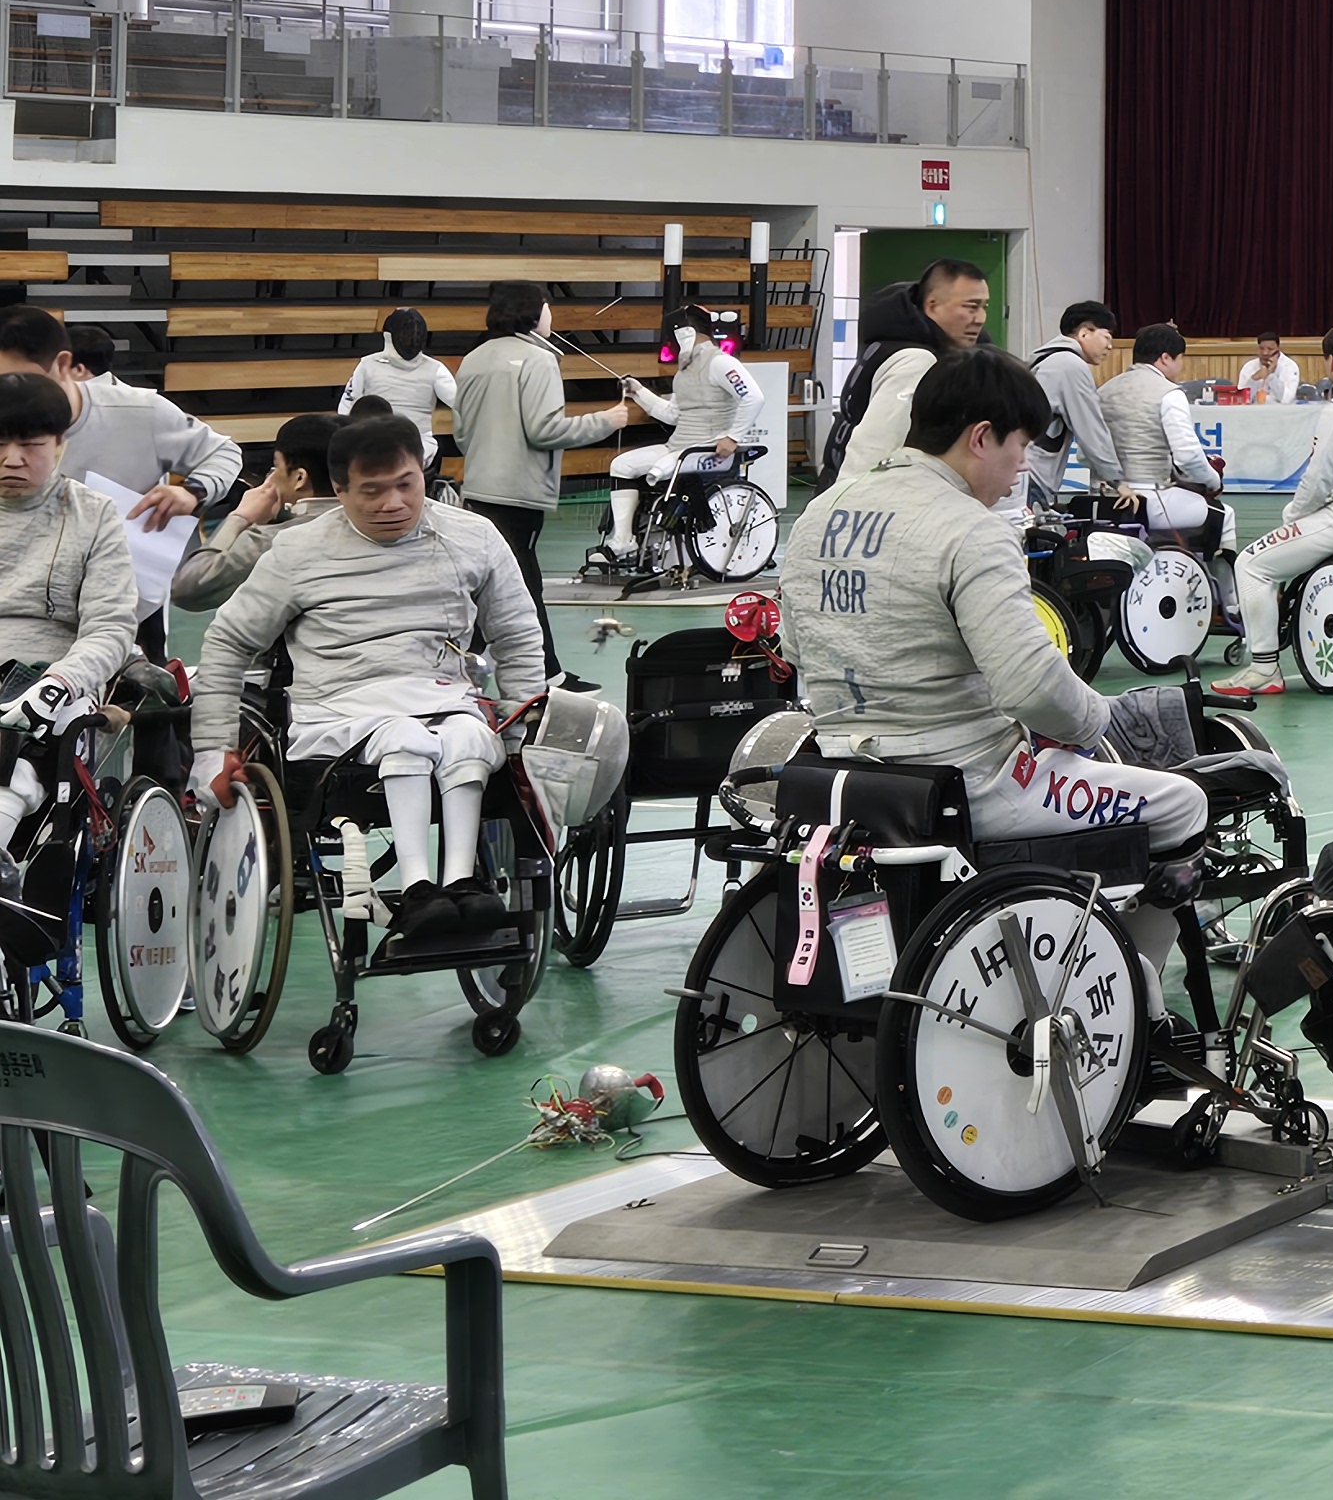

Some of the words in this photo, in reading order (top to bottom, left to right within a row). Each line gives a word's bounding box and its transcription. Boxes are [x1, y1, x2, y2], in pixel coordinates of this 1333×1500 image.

[819, 508, 896, 559] RYU
[1245, 522, 1303, 556] KOREA
[819, 568, 867, 614] KOR
[1042, 770, 1149, 825] KOREA
